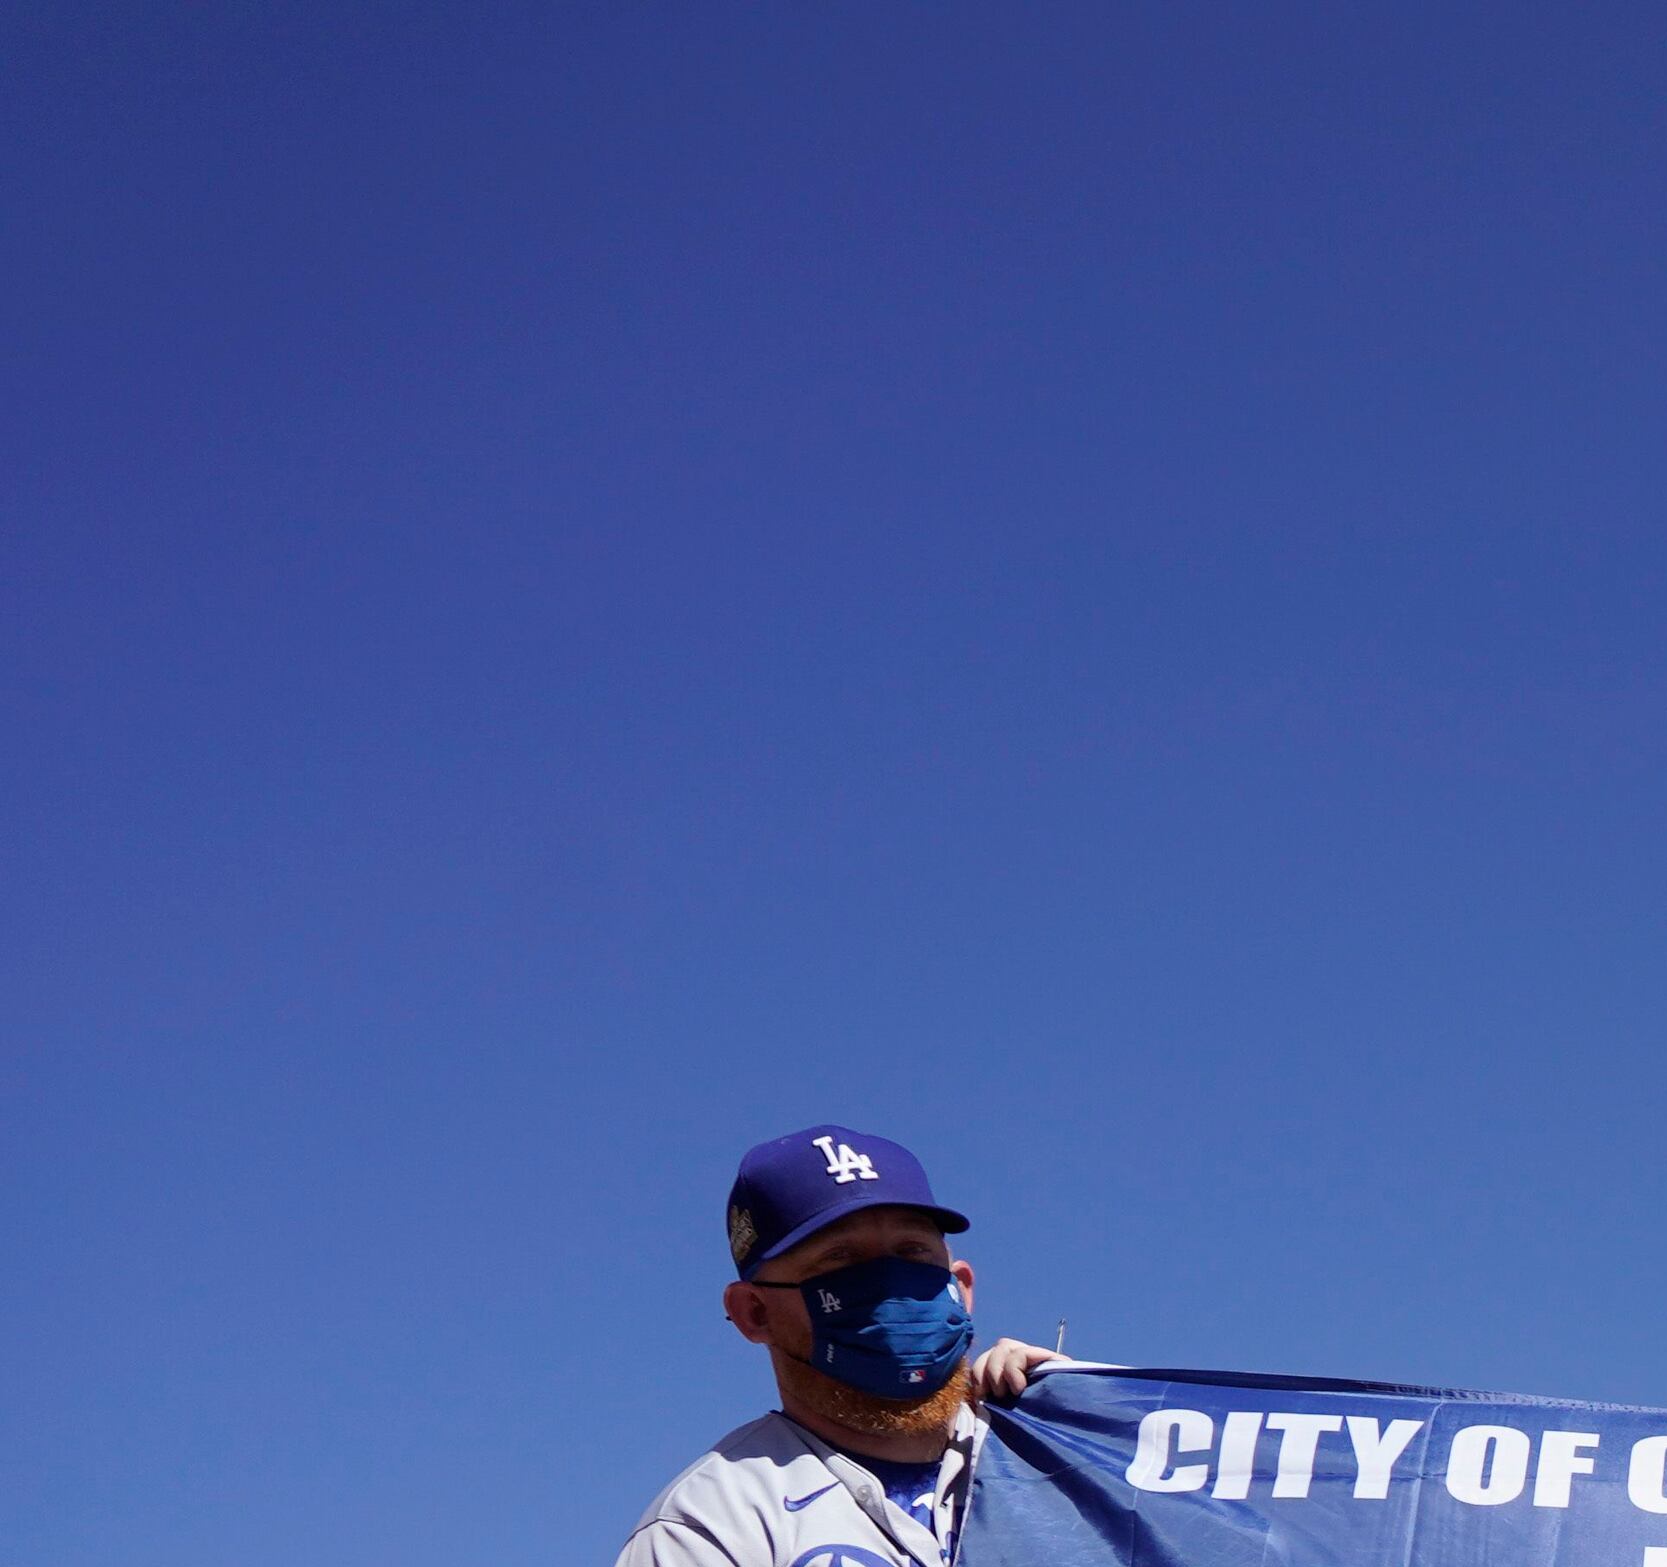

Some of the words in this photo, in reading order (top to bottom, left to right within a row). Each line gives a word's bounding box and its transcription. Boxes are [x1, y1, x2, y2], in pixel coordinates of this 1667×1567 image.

[812, 1135, 879, 1184] LA
[817, 1288, 842, 1314] LA
[1126, 1407, 1424, 1501] CITY
[1445, 1424, 1602, 1510] OF
